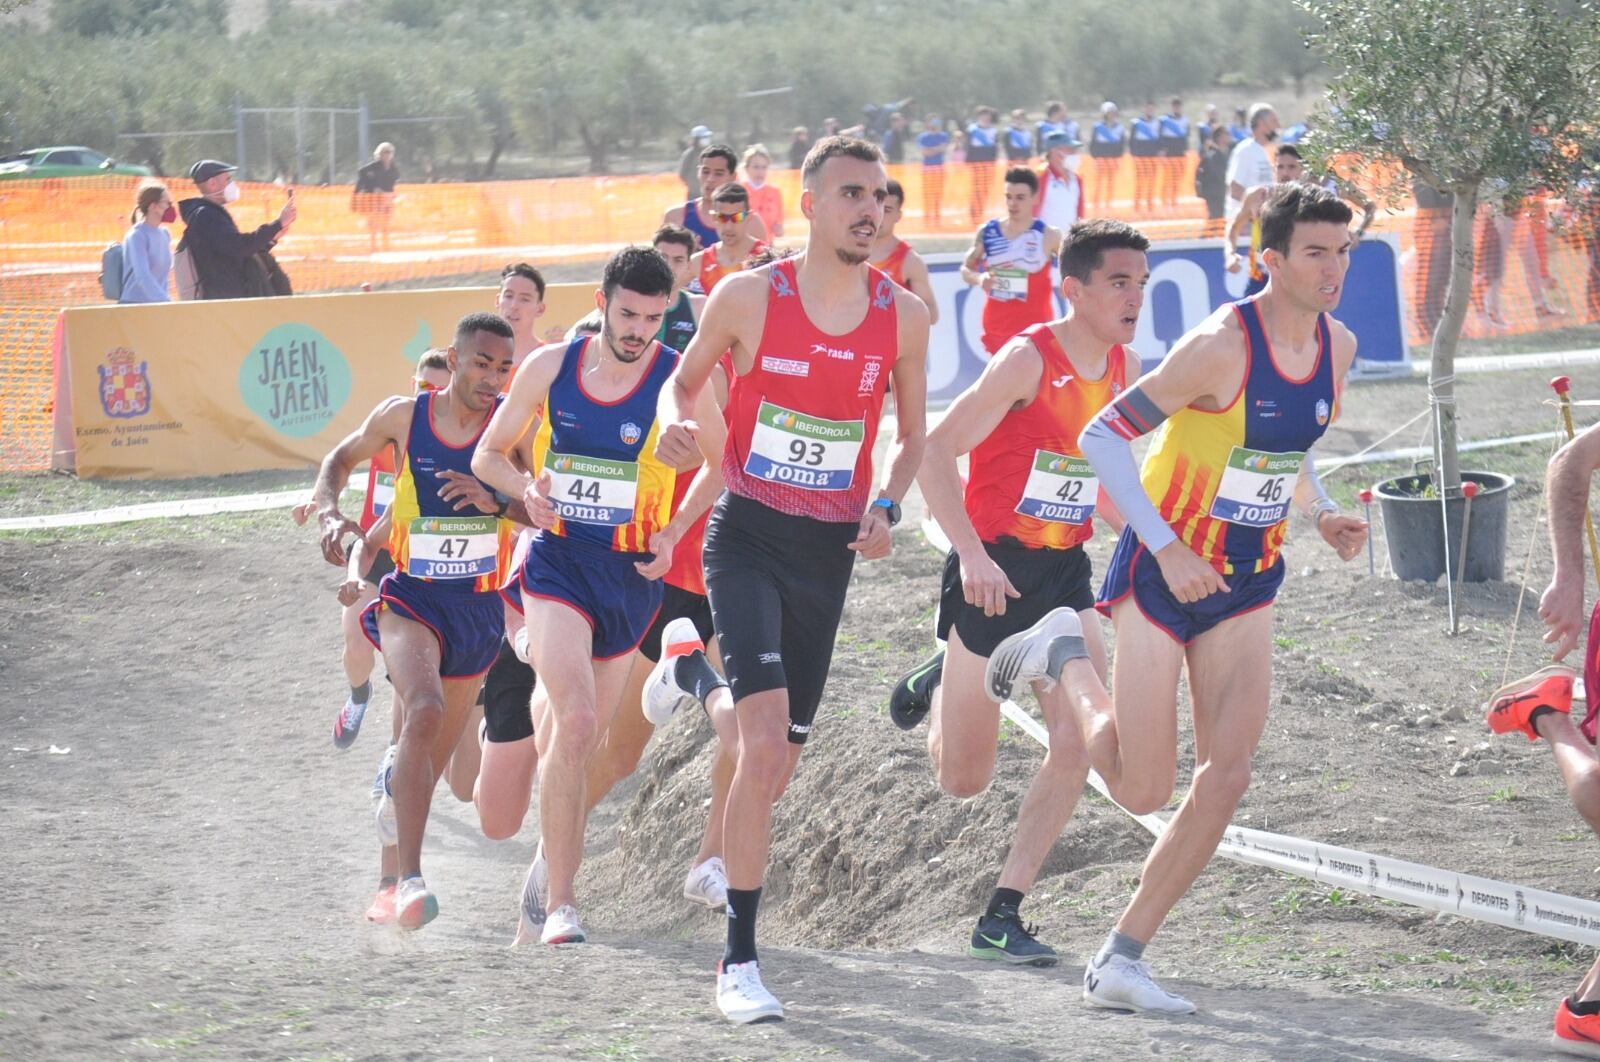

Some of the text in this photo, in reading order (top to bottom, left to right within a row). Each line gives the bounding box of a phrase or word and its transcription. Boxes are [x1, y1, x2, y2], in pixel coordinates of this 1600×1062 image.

[115, 421, 182, 435] Ayuntamiento
[794, 420, 850, 438] IBERDROLA
[111, 438, 123, 447] de
[787, 439, 826, 466] 93
[571, 461, 625, 476] IBERDROLA
[1266, 460, 1301, 470] IBERDRO
[567, 479, 601, 503] 44
[1056, 480, 1083, 503] 42
[1256, 477, 1284, 503] 46
[439, 522, 487, 532] IBERDROLA
[438, 539, 469, 559] 47
[1387, 872, 1426, 891] Ayuntamiento
[1427, 883, 1434, 893] de
[1471, 890, 1509, 911] DEPORTES
[1535, 905, 1578, 927] Ayuntamiento
[1579, 914, 1588, 926] de
